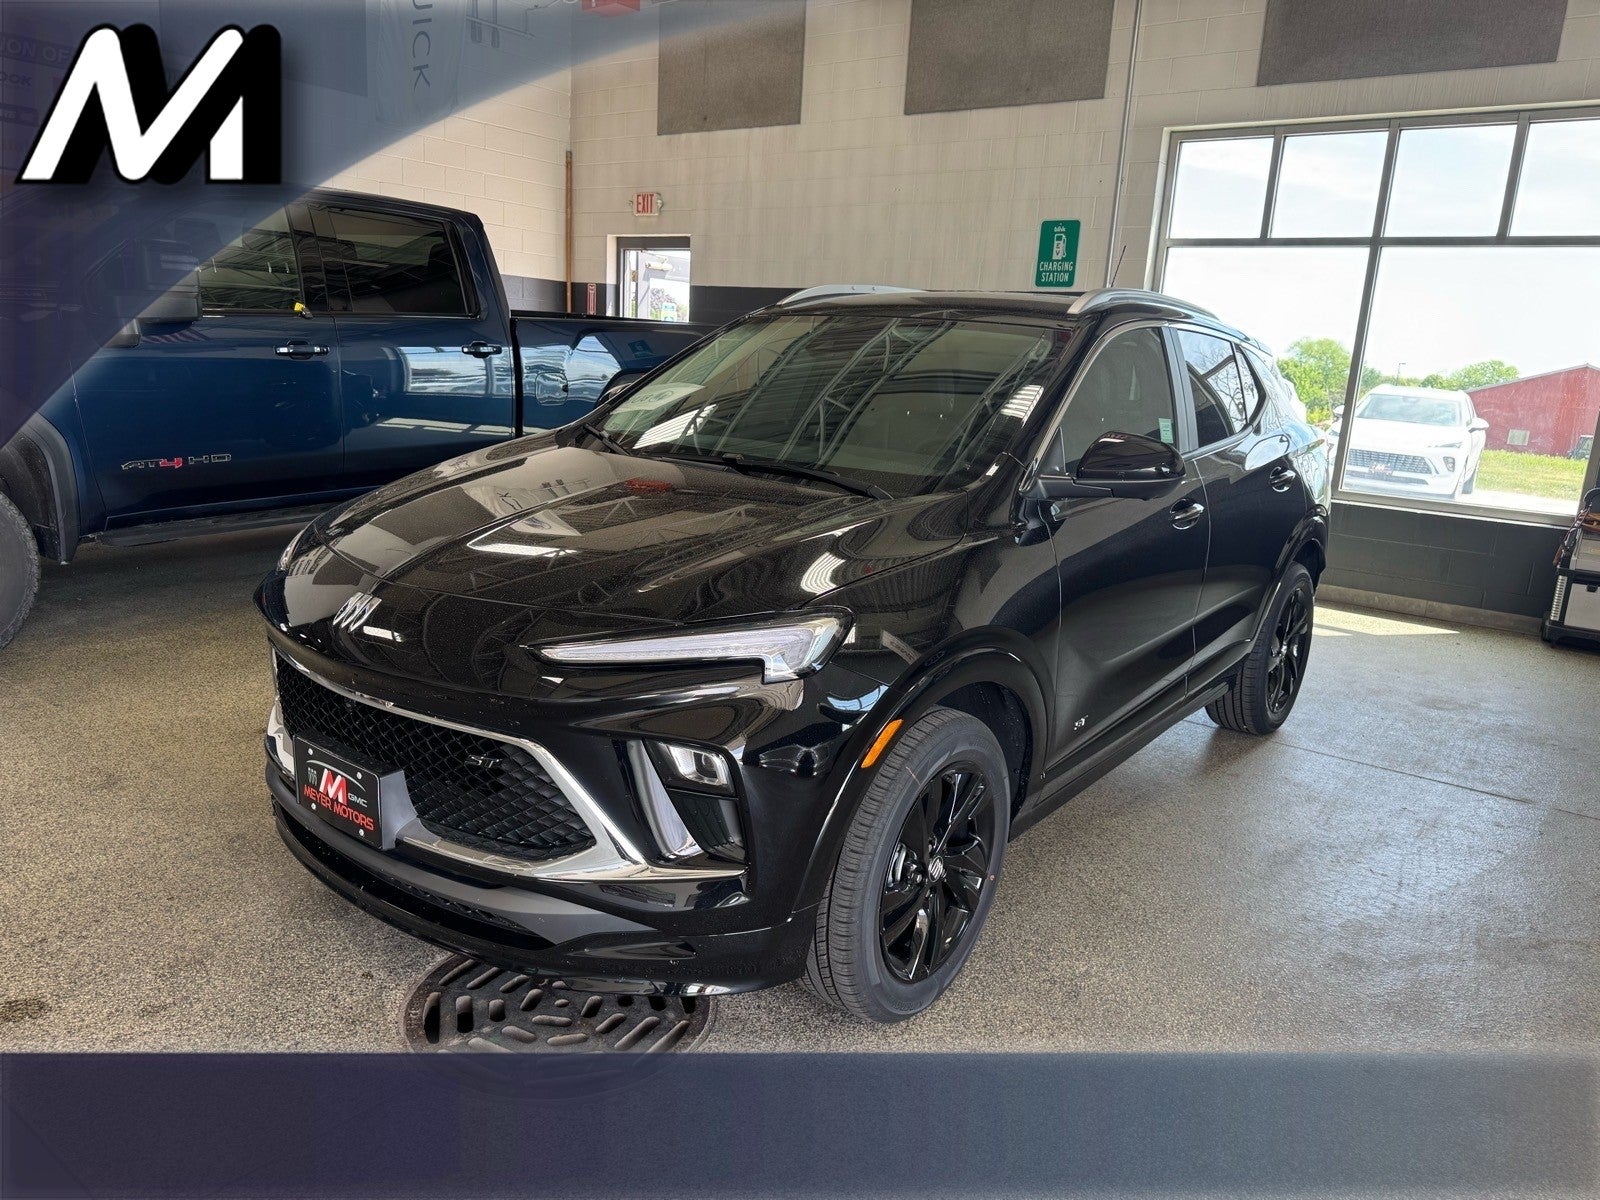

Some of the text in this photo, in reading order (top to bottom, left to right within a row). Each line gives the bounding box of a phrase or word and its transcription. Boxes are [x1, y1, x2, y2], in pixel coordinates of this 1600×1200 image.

[636, 193, 655, 214] EXIT
[1040, 261, 1074, 271] CHARGING
[1040, 272, 1070, 282] STATION
[121, 453, 232, 470] AT4 HD
[303, 784, 375, 831] MEYER MOTORS
[348, 792, 369, 808] GMC
